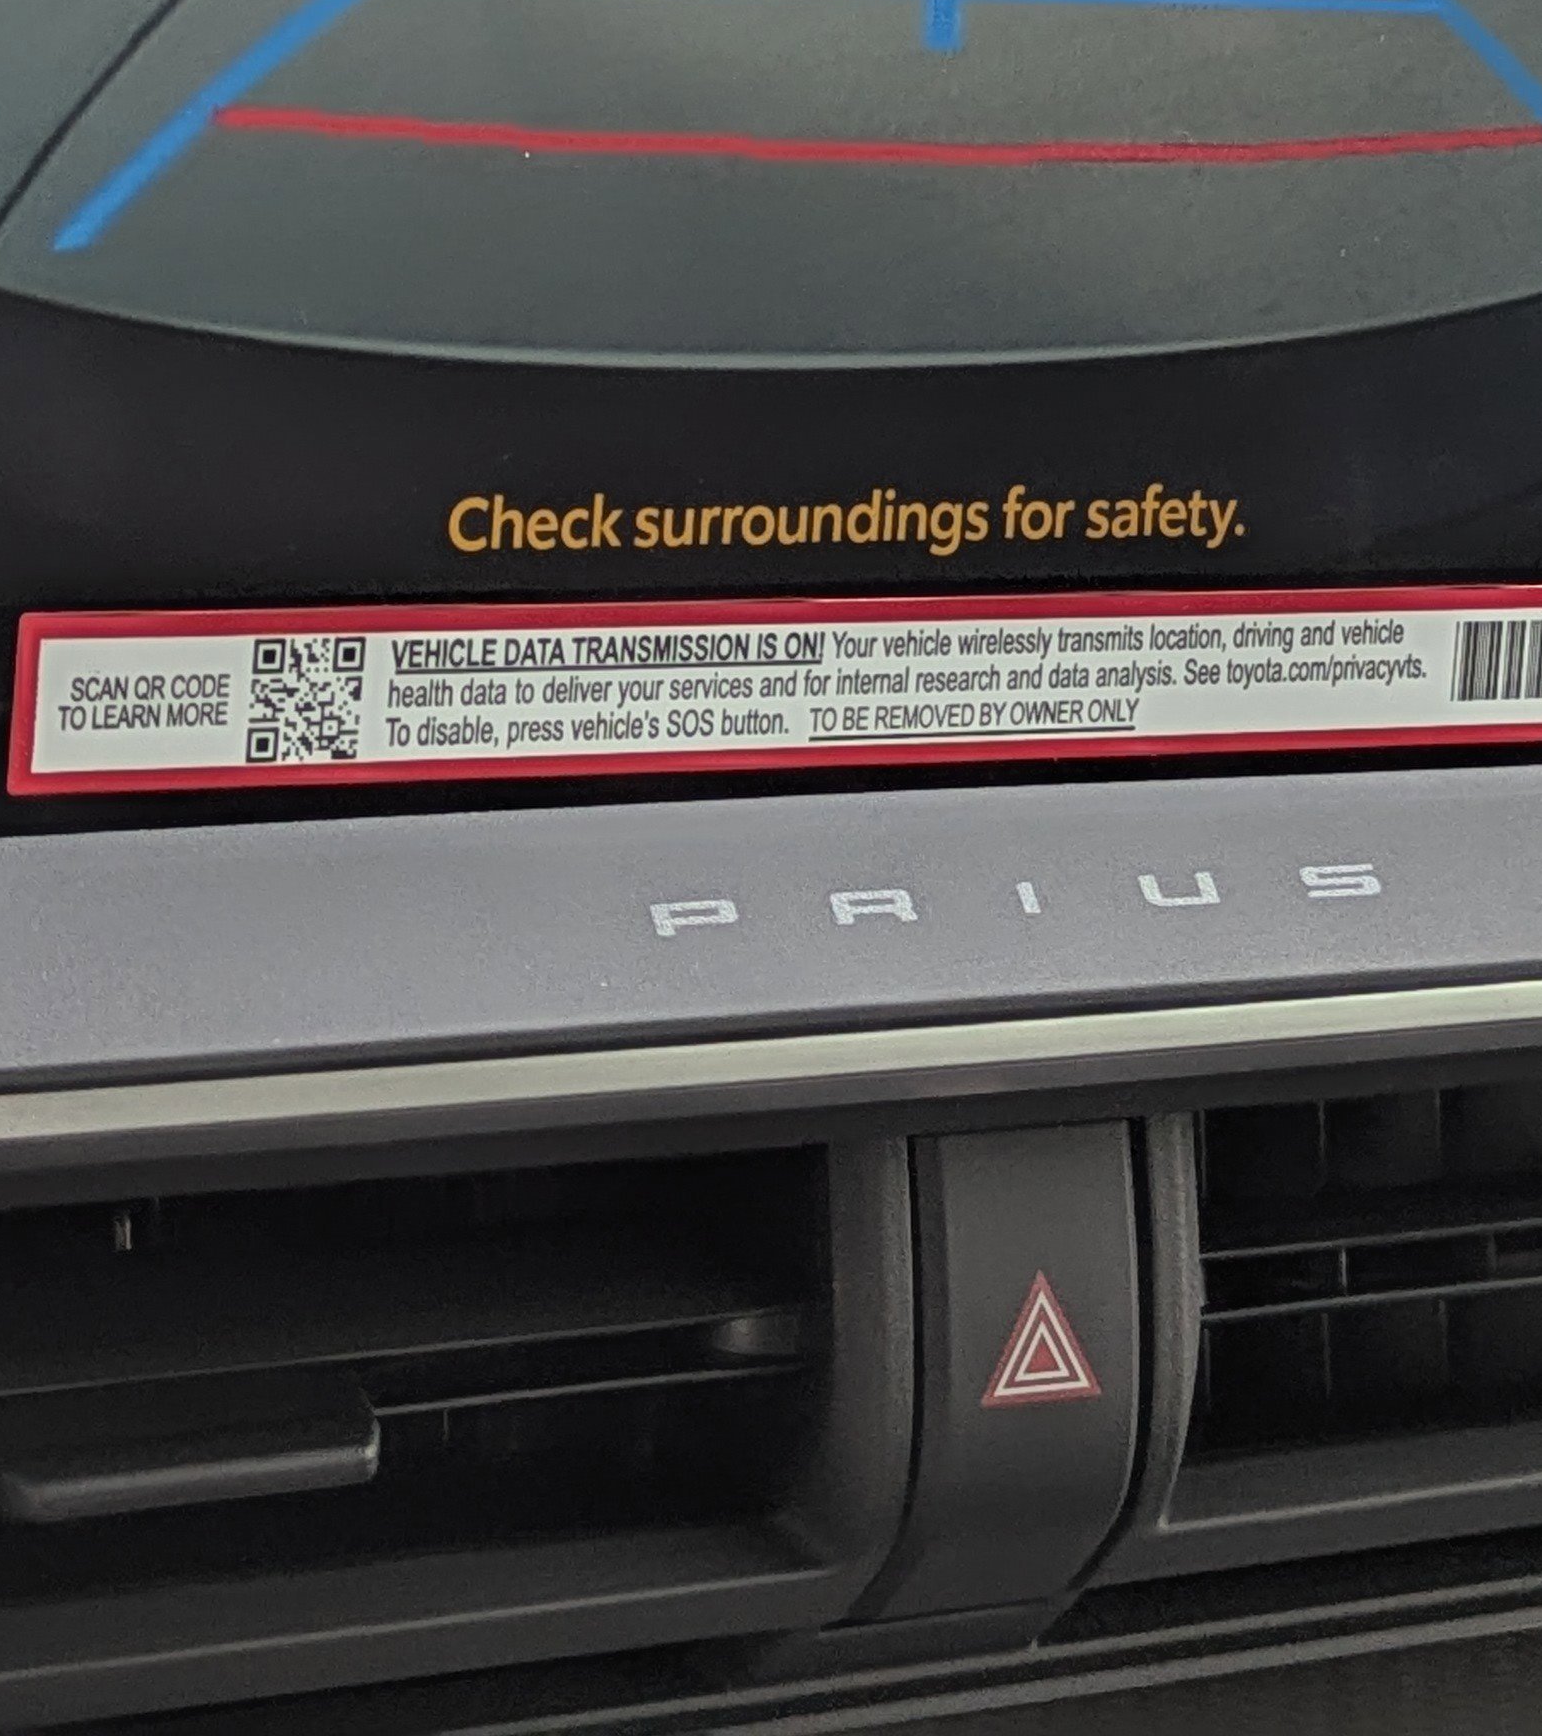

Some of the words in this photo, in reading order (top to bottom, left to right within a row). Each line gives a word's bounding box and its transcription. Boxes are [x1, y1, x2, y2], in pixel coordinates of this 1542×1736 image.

[448, 492, 624, 552] Check
[633, 488, 990, 557] surroundings
[1002, 484, 1076, 541] for
[1085, 482, 1245, 549] safety.
[391, 638, 499, 668] VEHICLE
[503, 637, 567, 666] DATA
[571, 632, 751, 665] TRANSMISSION
[756, 632, 778, 660] IS
[783, 631, 827, 660] ON!
[832, 630, 878, 660] Your
[882, 628, 952, 658] vehicle
[958, 626, 1053, 660] wirelessly
[1058, 624, 1144, 653] transmits
[1149, 622, 1227, 653] location,
[1232, 621, 1294, 654] driving
[1300, 620, 1336, 647] and
[1341, 618, 1405, 646] vehicle
[70, 675, 130, 702] SCAN
[134, 674, 166, 701] QR
[170, 673, 231, 699] CODE
[387, 679, 454, 709] health
[460, 677, 507, 706] data
[515, 677, 535, 705] to
[542, 675, 613, 704] deliver
[617, 677, 665, 709] your
[668, 672, 753, 701] services
[759, 669, 798, 697] and
[803, 668, 831, 697] for
[835, 666, 909, 696] internal
[915, 664, 1001, 694] research
[1006, 663, 1043, 691] and
[1048, 662, 1090, 690] data
[1095, 660, 1178, 694] analysis.
[1183, 658, 1221, 686] See
[1226, 653, 1427, 690] toyota.com/privacyvts.
[58, 705, 87, 731] TO
[91, 703, 162, 730] LEARN
[166, 701, 229, 727] MORE
[385, 717, 411, 747] To
[416, 715, 500, 748] disable,
[506, 718, 564, 751] press
[571, 710, 661, 742] vehicle's
[666, 709, 715, 738] SOS
[720, 707, 790, 736] button.
[809, 707, 838, 732] TO
[842, 706, 870, 731] BE
[874, 703, 975, 730] REMOVED
[979, 701, 1008, 727] BY
[1010, 700, 1085, 726] OWNER
[1088, 697, 1140, 723] ONLY
[649, 862, 1382, 937] PRIUS
